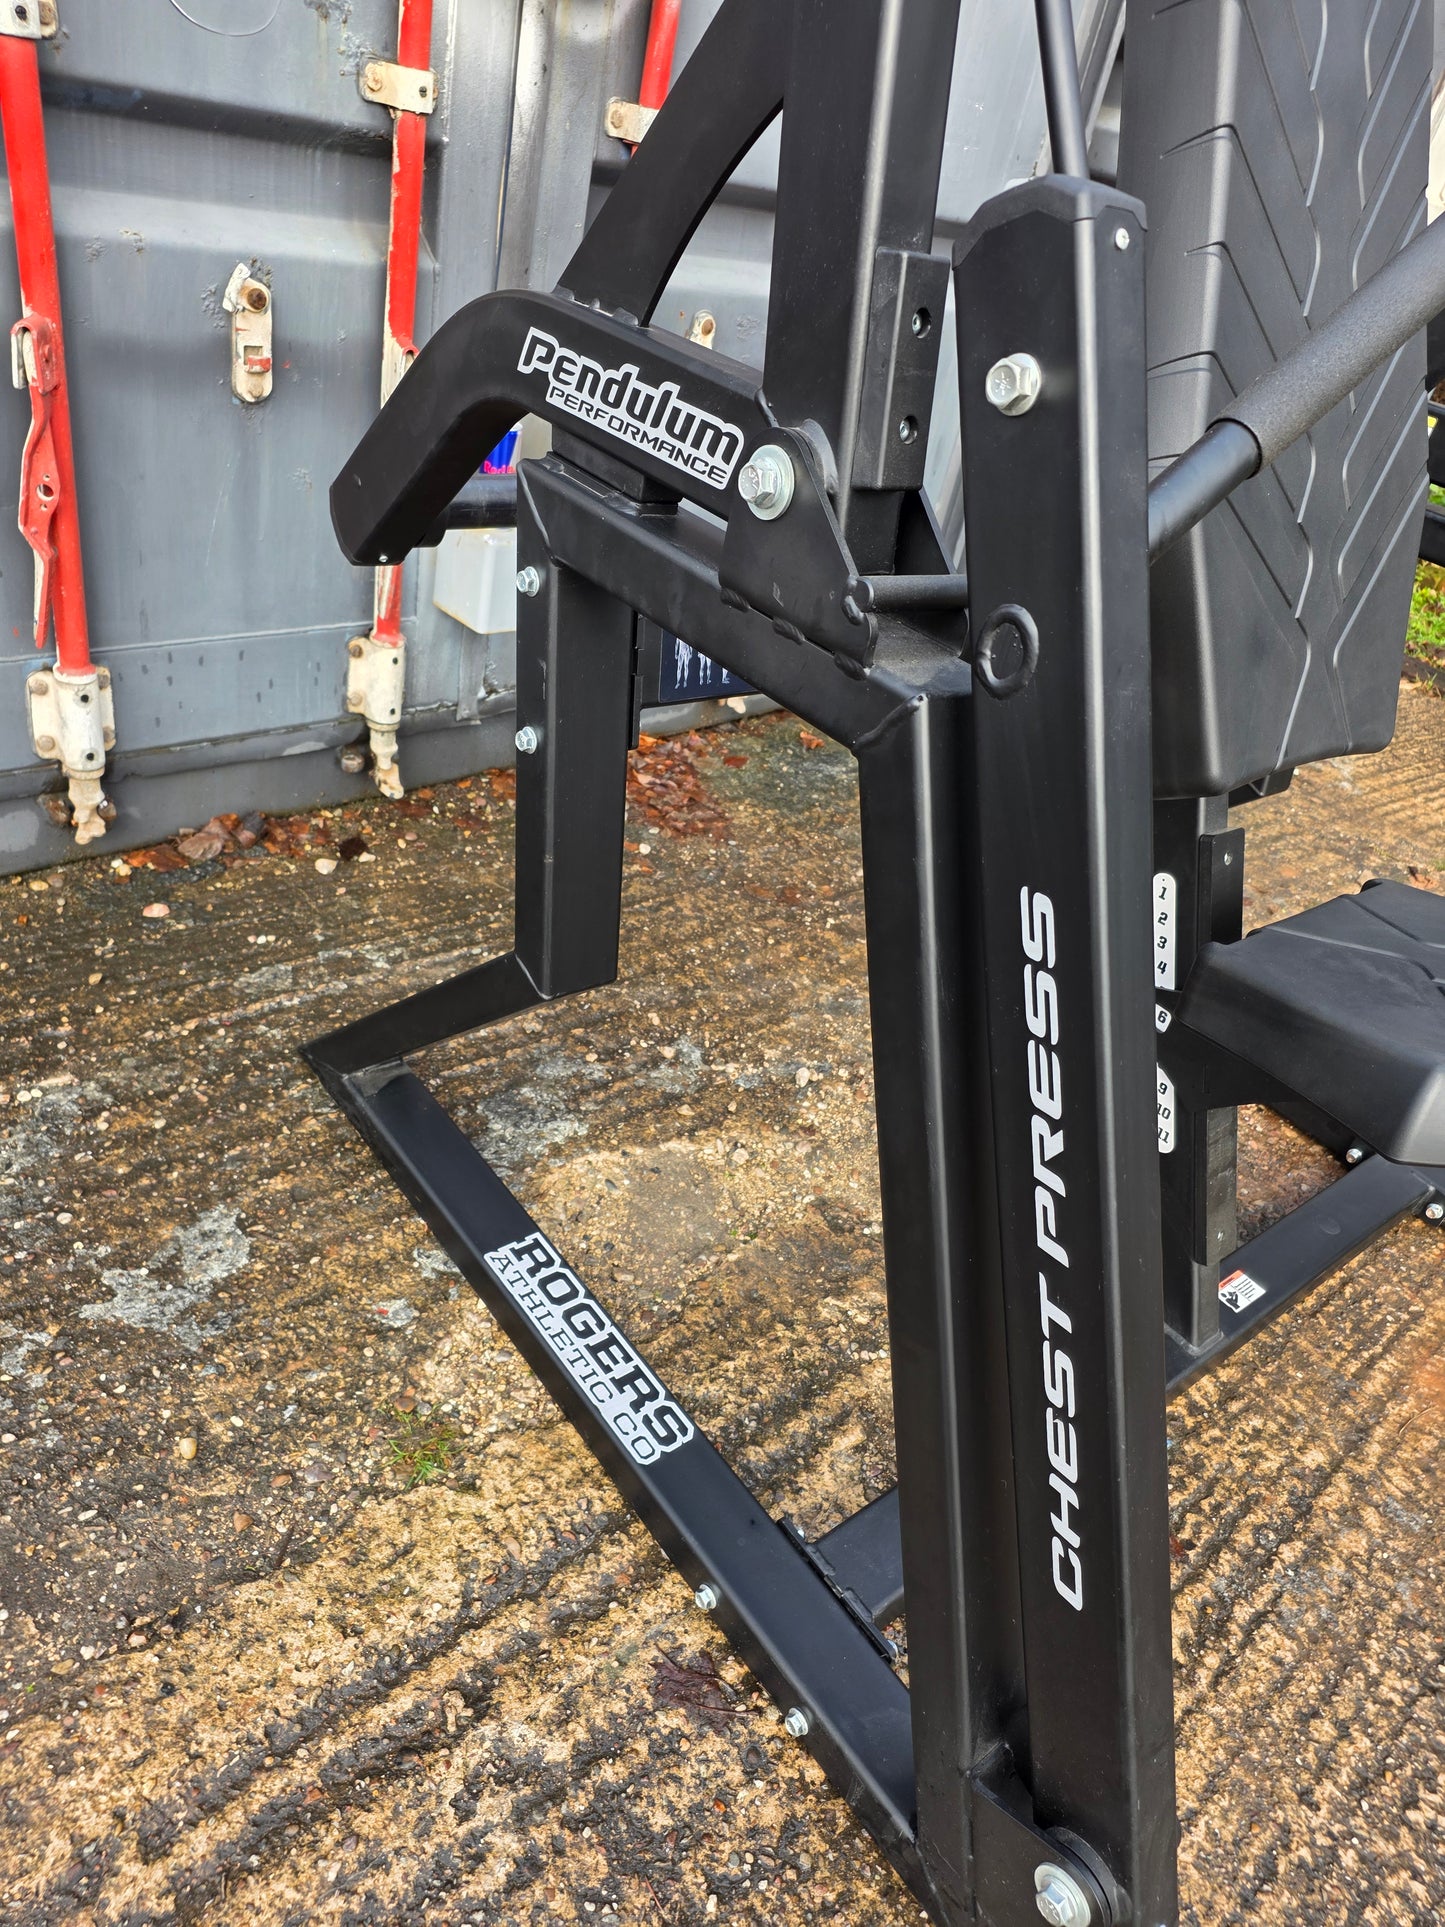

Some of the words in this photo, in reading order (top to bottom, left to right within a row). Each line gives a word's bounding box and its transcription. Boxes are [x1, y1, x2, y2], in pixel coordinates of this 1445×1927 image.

[549, 385, 728, 485] PERFORMANCE
[1158, 886, 1167, 900] 1
[1157, 912, 1168, 926] 2
[1157, 936, 1168, 950] 3
[1157, 960, 1168, 975] 4
[1157, 1010, 1168, 1024] 6
[1019, 885, 1069, 1269] PRESS
[1157, 1082, 1168, 1095] 9
[1157, 1102, 1171, 1120] 10
[1158, 1126, 1170, 1144] 11
[508, 1236, 690, 1448] ROGERS
[491, 1253, 615, 1404] ATHLETIC
[612, 1411, 656, 1460] CO
[1038, 1271, 1083, 1612] CHEST
